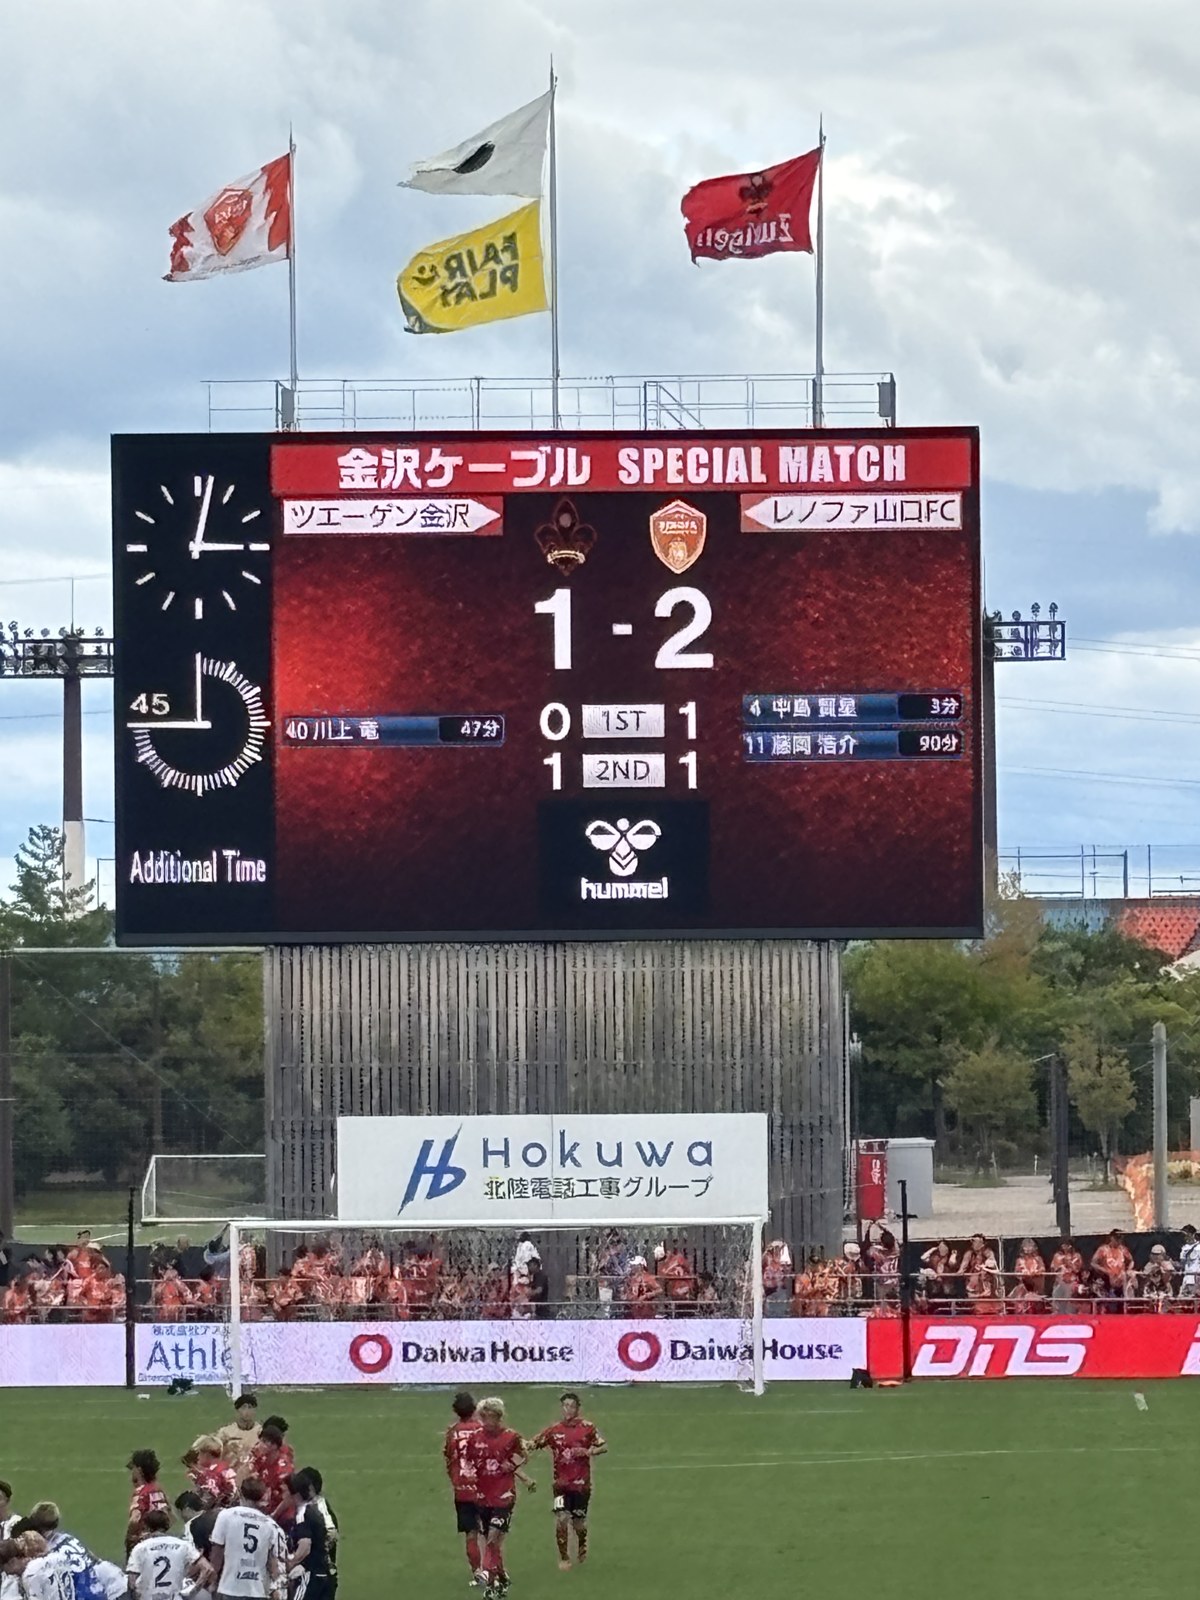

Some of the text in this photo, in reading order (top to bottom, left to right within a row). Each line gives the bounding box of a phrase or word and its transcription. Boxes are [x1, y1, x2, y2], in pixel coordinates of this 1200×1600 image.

[337, 445, 907, 490] 金沢ケーブル SPECIAL MATCH
[773, 498, 957, 524] レノファ山口FC
[534, 588, 572, 670] 1
[654, 586, 714, 669] 2
[130, 693, 170, 715] 45
[286, 720, 308, 740] 40
[540, 701, 697, 741] 0 1ST 1
[746, 735, 764, 754] 11
[543, 751, 698, 790] 1 2ND 1
[130, 849, 266, 883] Additional Time
[581, 876, 668, 900] hummel
[482, 1129, 713, 1168] Hokuwa
[402, 1339, 575, 1364] Daiwa House
[670, 1338, 844, 1361] Daiwa House
[243, 1522, 260, 1554] 5
[153, 1555, 172, 1588] 2
